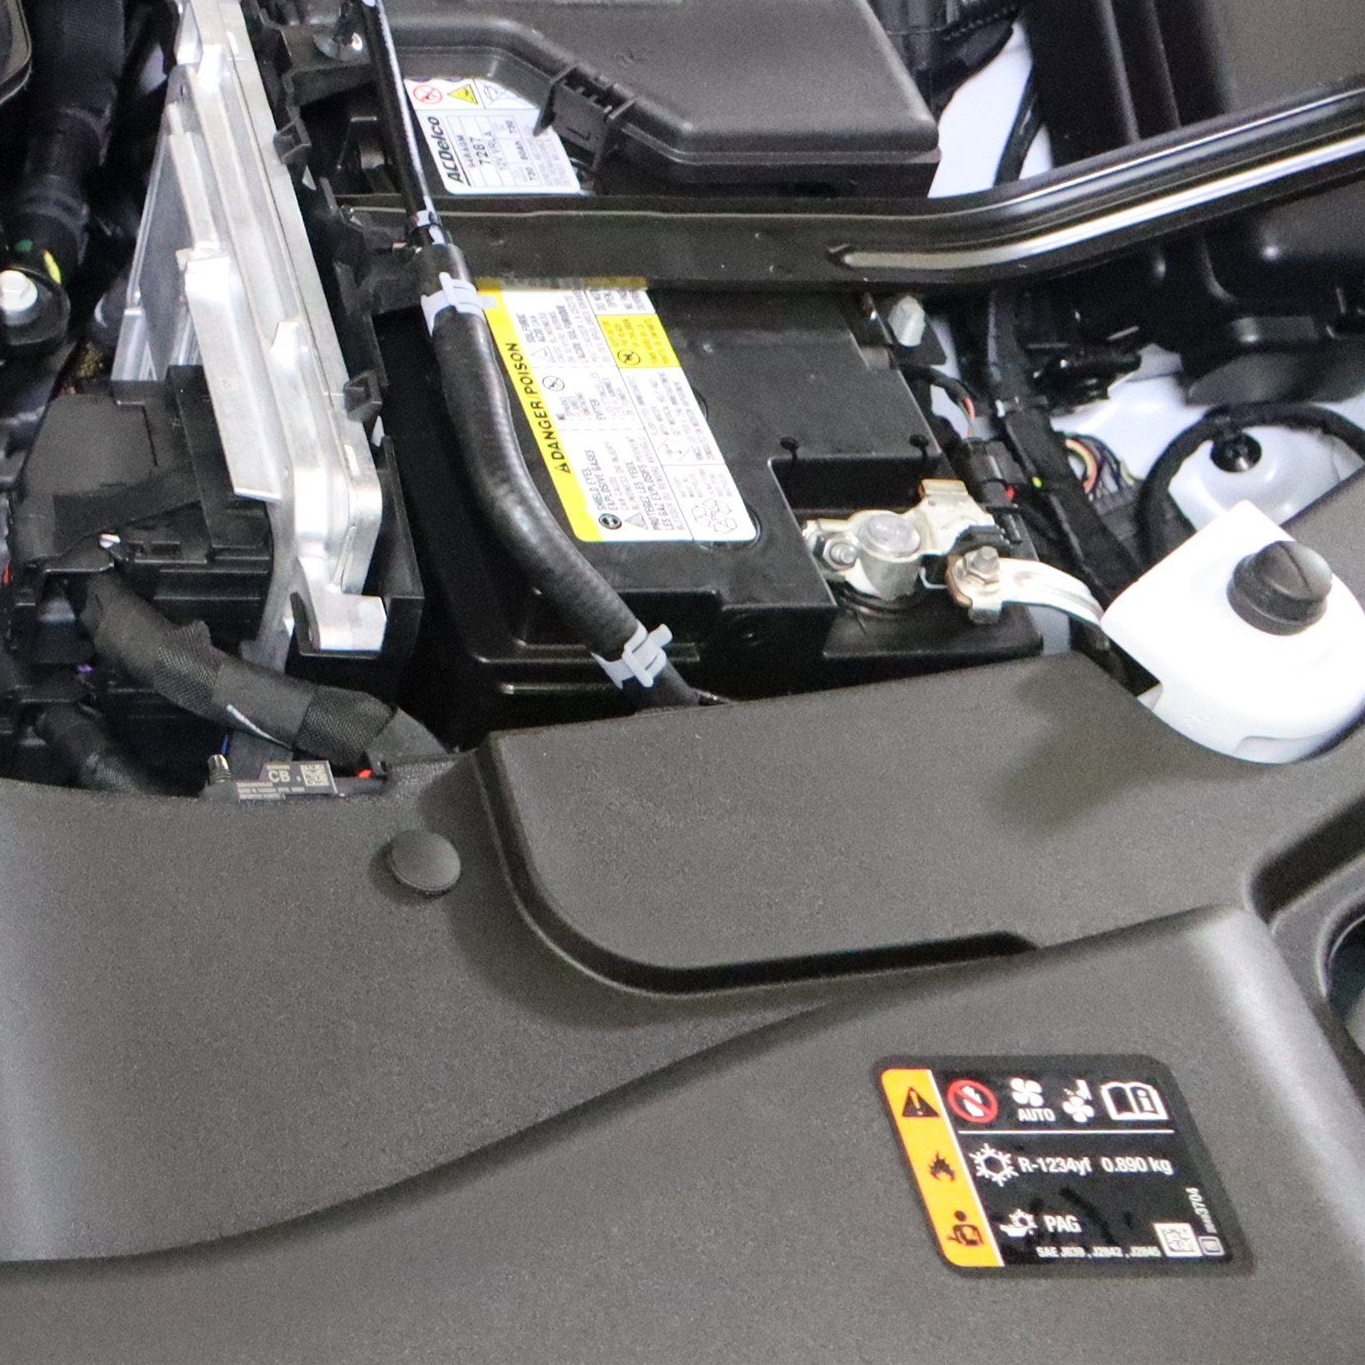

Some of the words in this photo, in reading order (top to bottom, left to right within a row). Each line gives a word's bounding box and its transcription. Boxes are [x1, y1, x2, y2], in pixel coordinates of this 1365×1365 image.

[428, 116, 462, 182] ACDelco
[469, 137, 490, 165] 7287
[584, 450, 601, 470] GASES
[594, 474, 618, 510] EXPLOSIVE
[268, 769, 291, 783] CB
[1017, 1108, 1056, 1122] AUTO
[1018, 1156, 1092, 1176] R-1234yf
[1101, 1156, 1147, 1173] 0.890
[1147, 1156, 1174, 1176] kg
[1043, 1214, 1082, 1233] PAG
[1036, 1246, 1059, 1258] SAE
